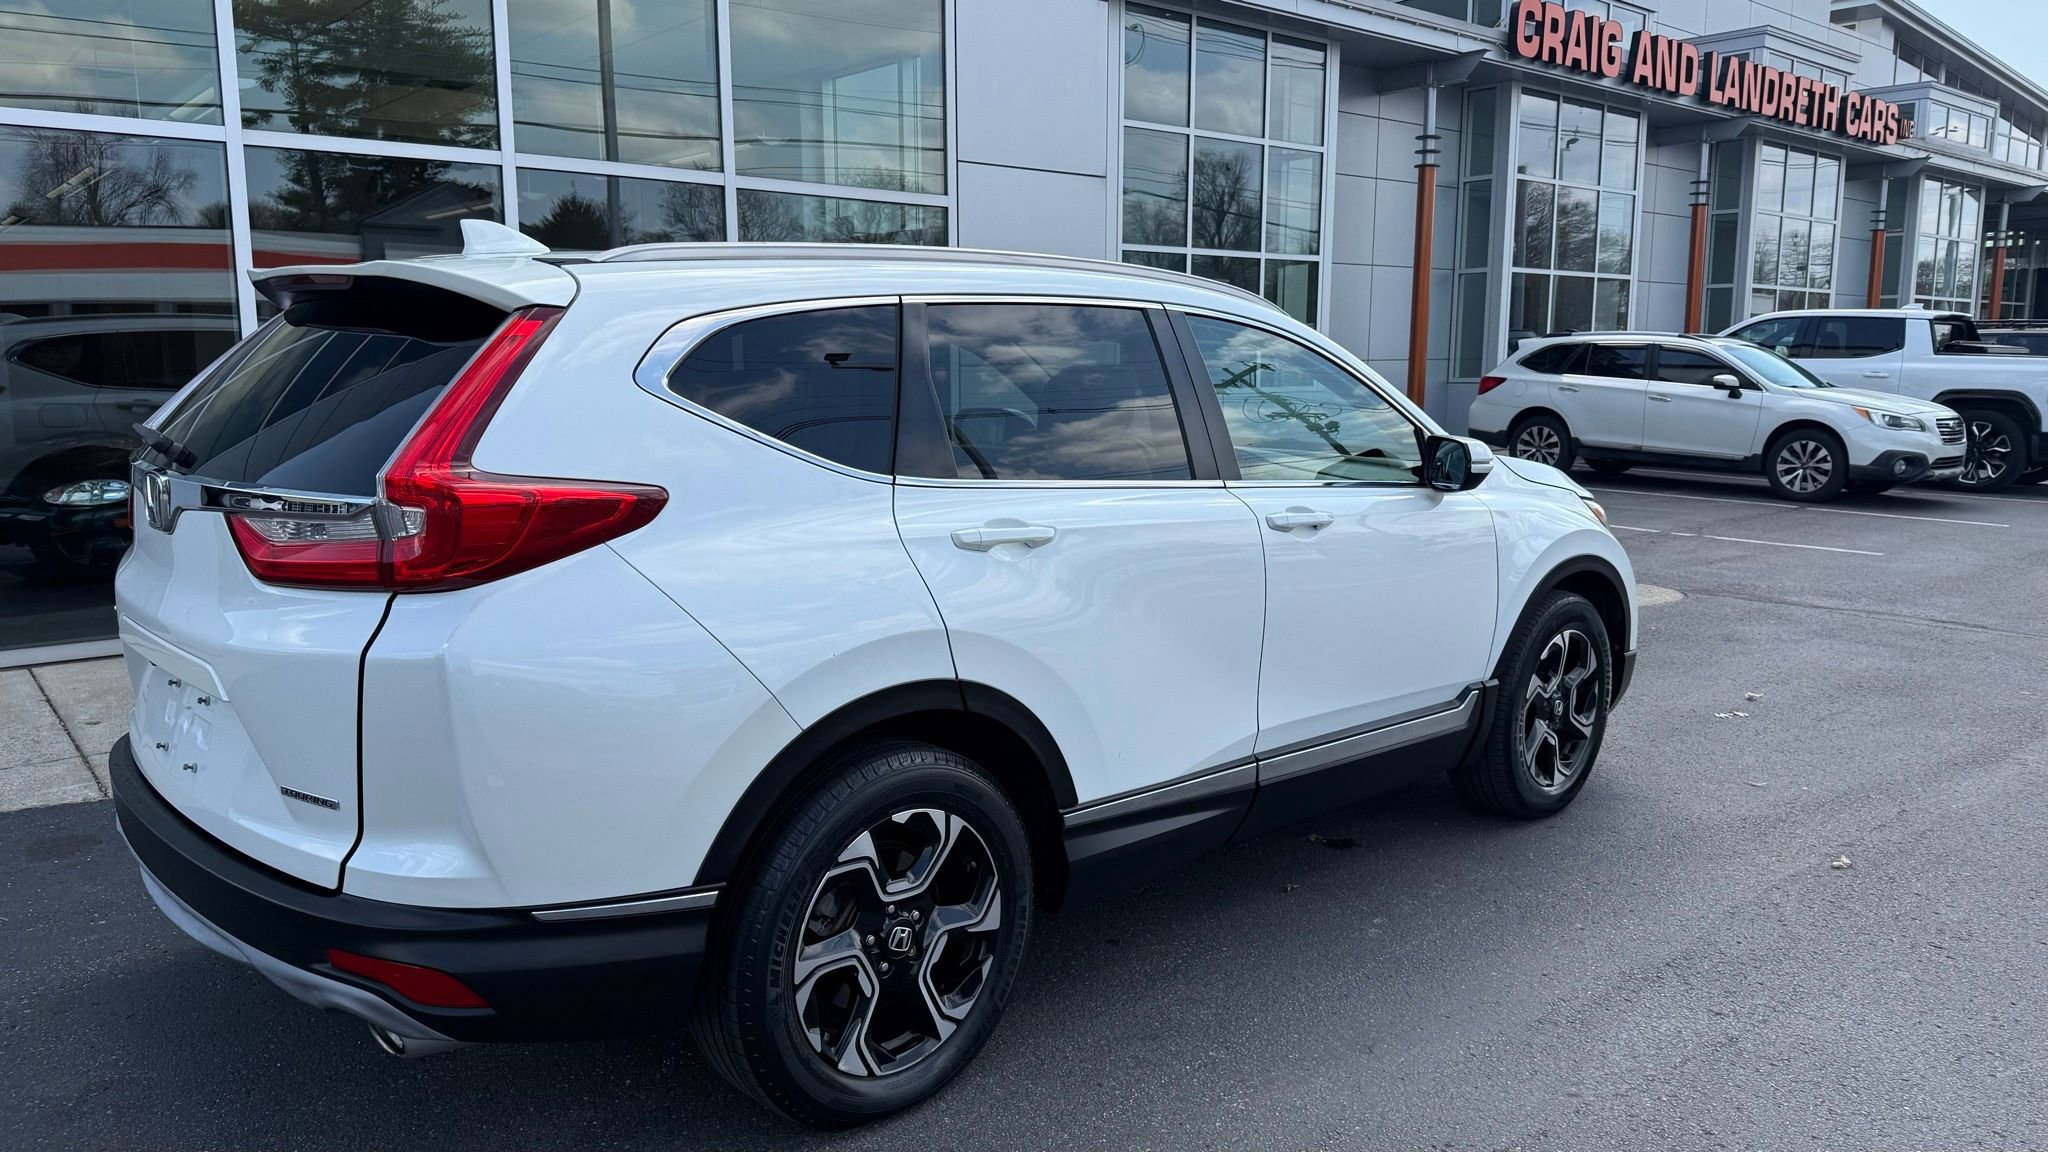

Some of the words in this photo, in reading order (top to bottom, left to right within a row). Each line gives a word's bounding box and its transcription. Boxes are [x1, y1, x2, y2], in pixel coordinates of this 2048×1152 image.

[1516, 0, 1623, 78] CRAIG
[1633, 31, 1699, 96] AND
[1709, 51, 1839, 131] LANDRETH
[1846, 91, 1898, 145] CARS
[281, 786, 336, 809] TOURING
